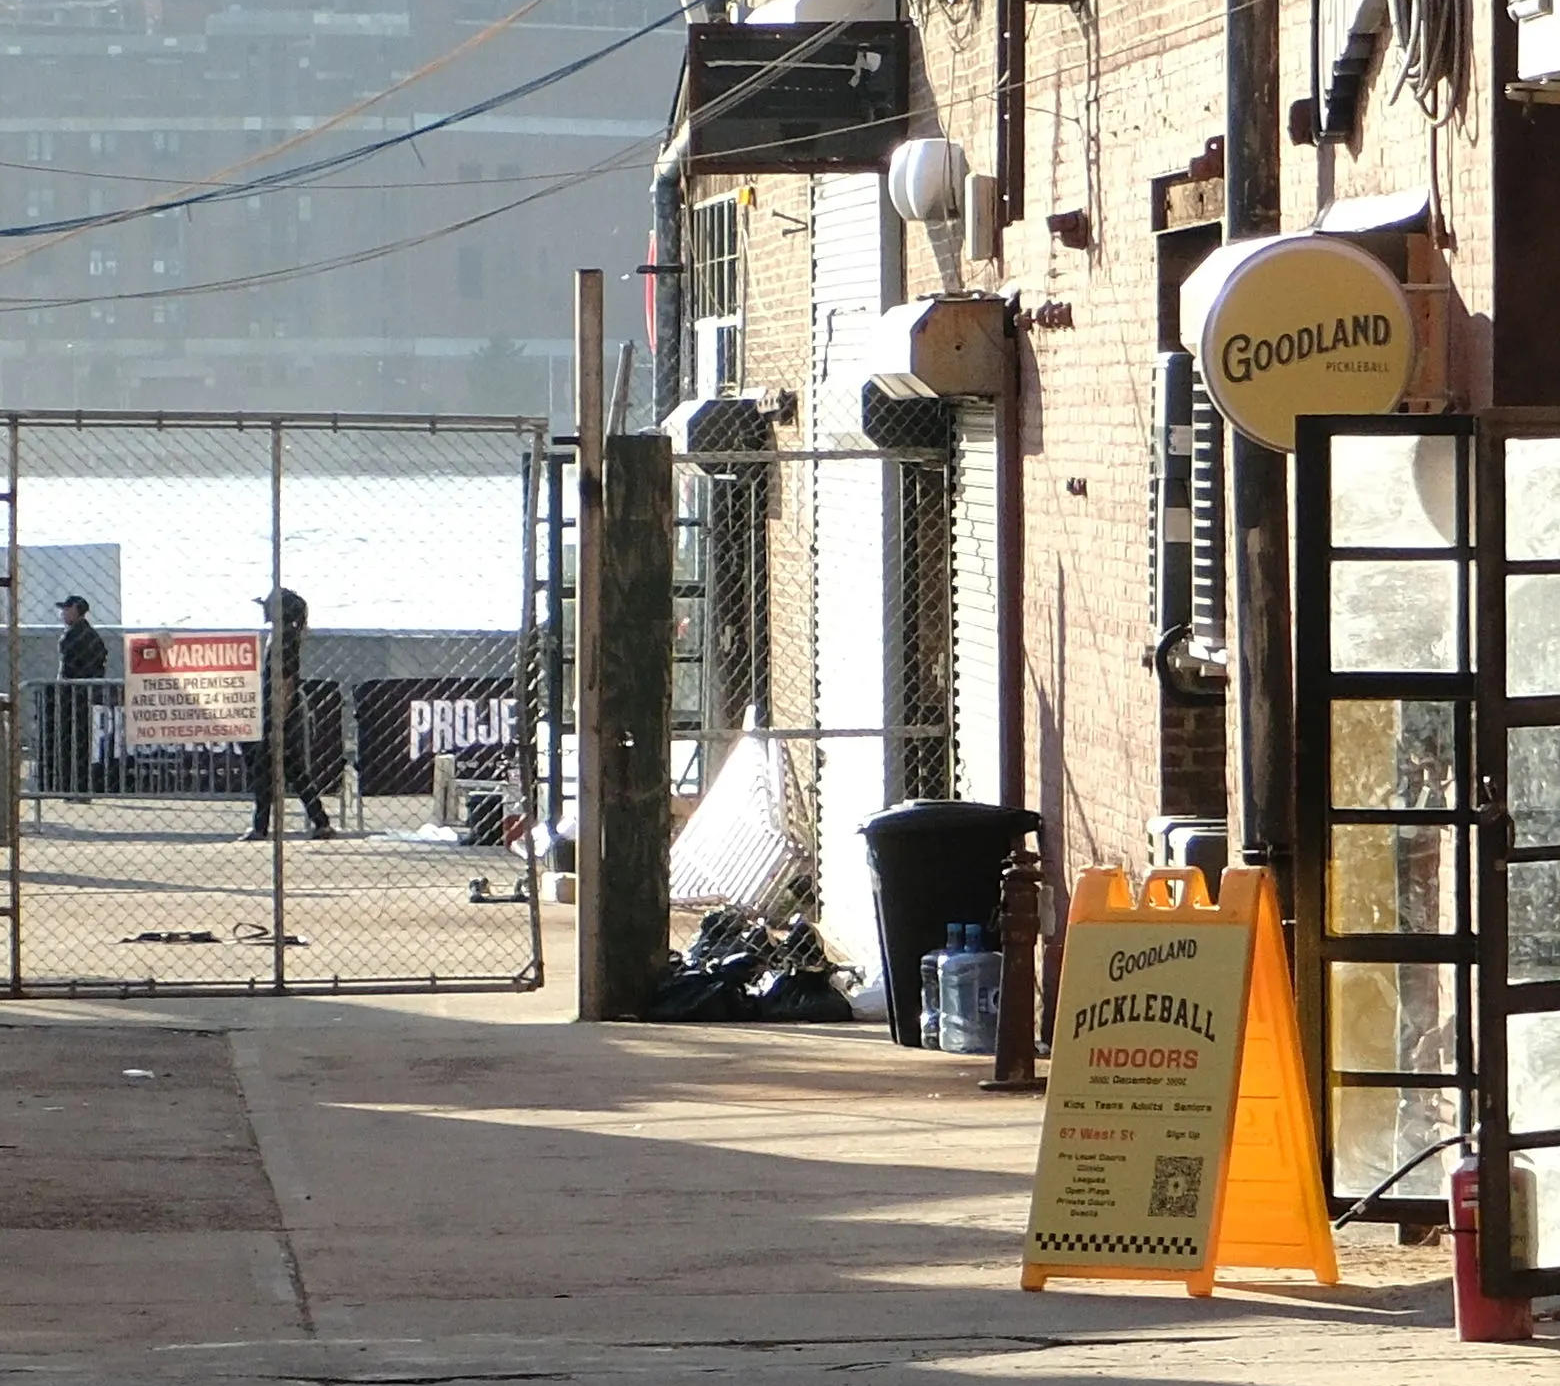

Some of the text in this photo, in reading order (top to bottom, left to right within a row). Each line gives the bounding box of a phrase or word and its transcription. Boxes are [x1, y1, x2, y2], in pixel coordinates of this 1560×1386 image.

[1222, 314, 1392, 383] GOODLAND
[1326, 361, 1390, 373] PICKLEBALL
[160, 643, 254, 669] WARNING
[143, 676, 245, 691] THESE PREMISES
[132, 691, 257, 706] ARE UNDER 24 HOUR
[133, 707, 257, 722] VIDEO SURVEILLANCE
[137, 724, 252, 738] NO TRESPASSING
[1109, 938, 1197, 982] GOODLAND
[1073, 994, 1215, 1042] PICKLEBALL
[1089, 1048, 1199, 1070] INDOORS
[1113, 1075, 1162, 1085] December
[1064, 1100, 1086, 1110] Kids
[1131, 1102, 1163, 1112] Adults
[1174, 1102, 1212, 1112] Seniors
[1080, 1127, 1115, 1141] West
[1120, 1129, 1135, 1141] St
